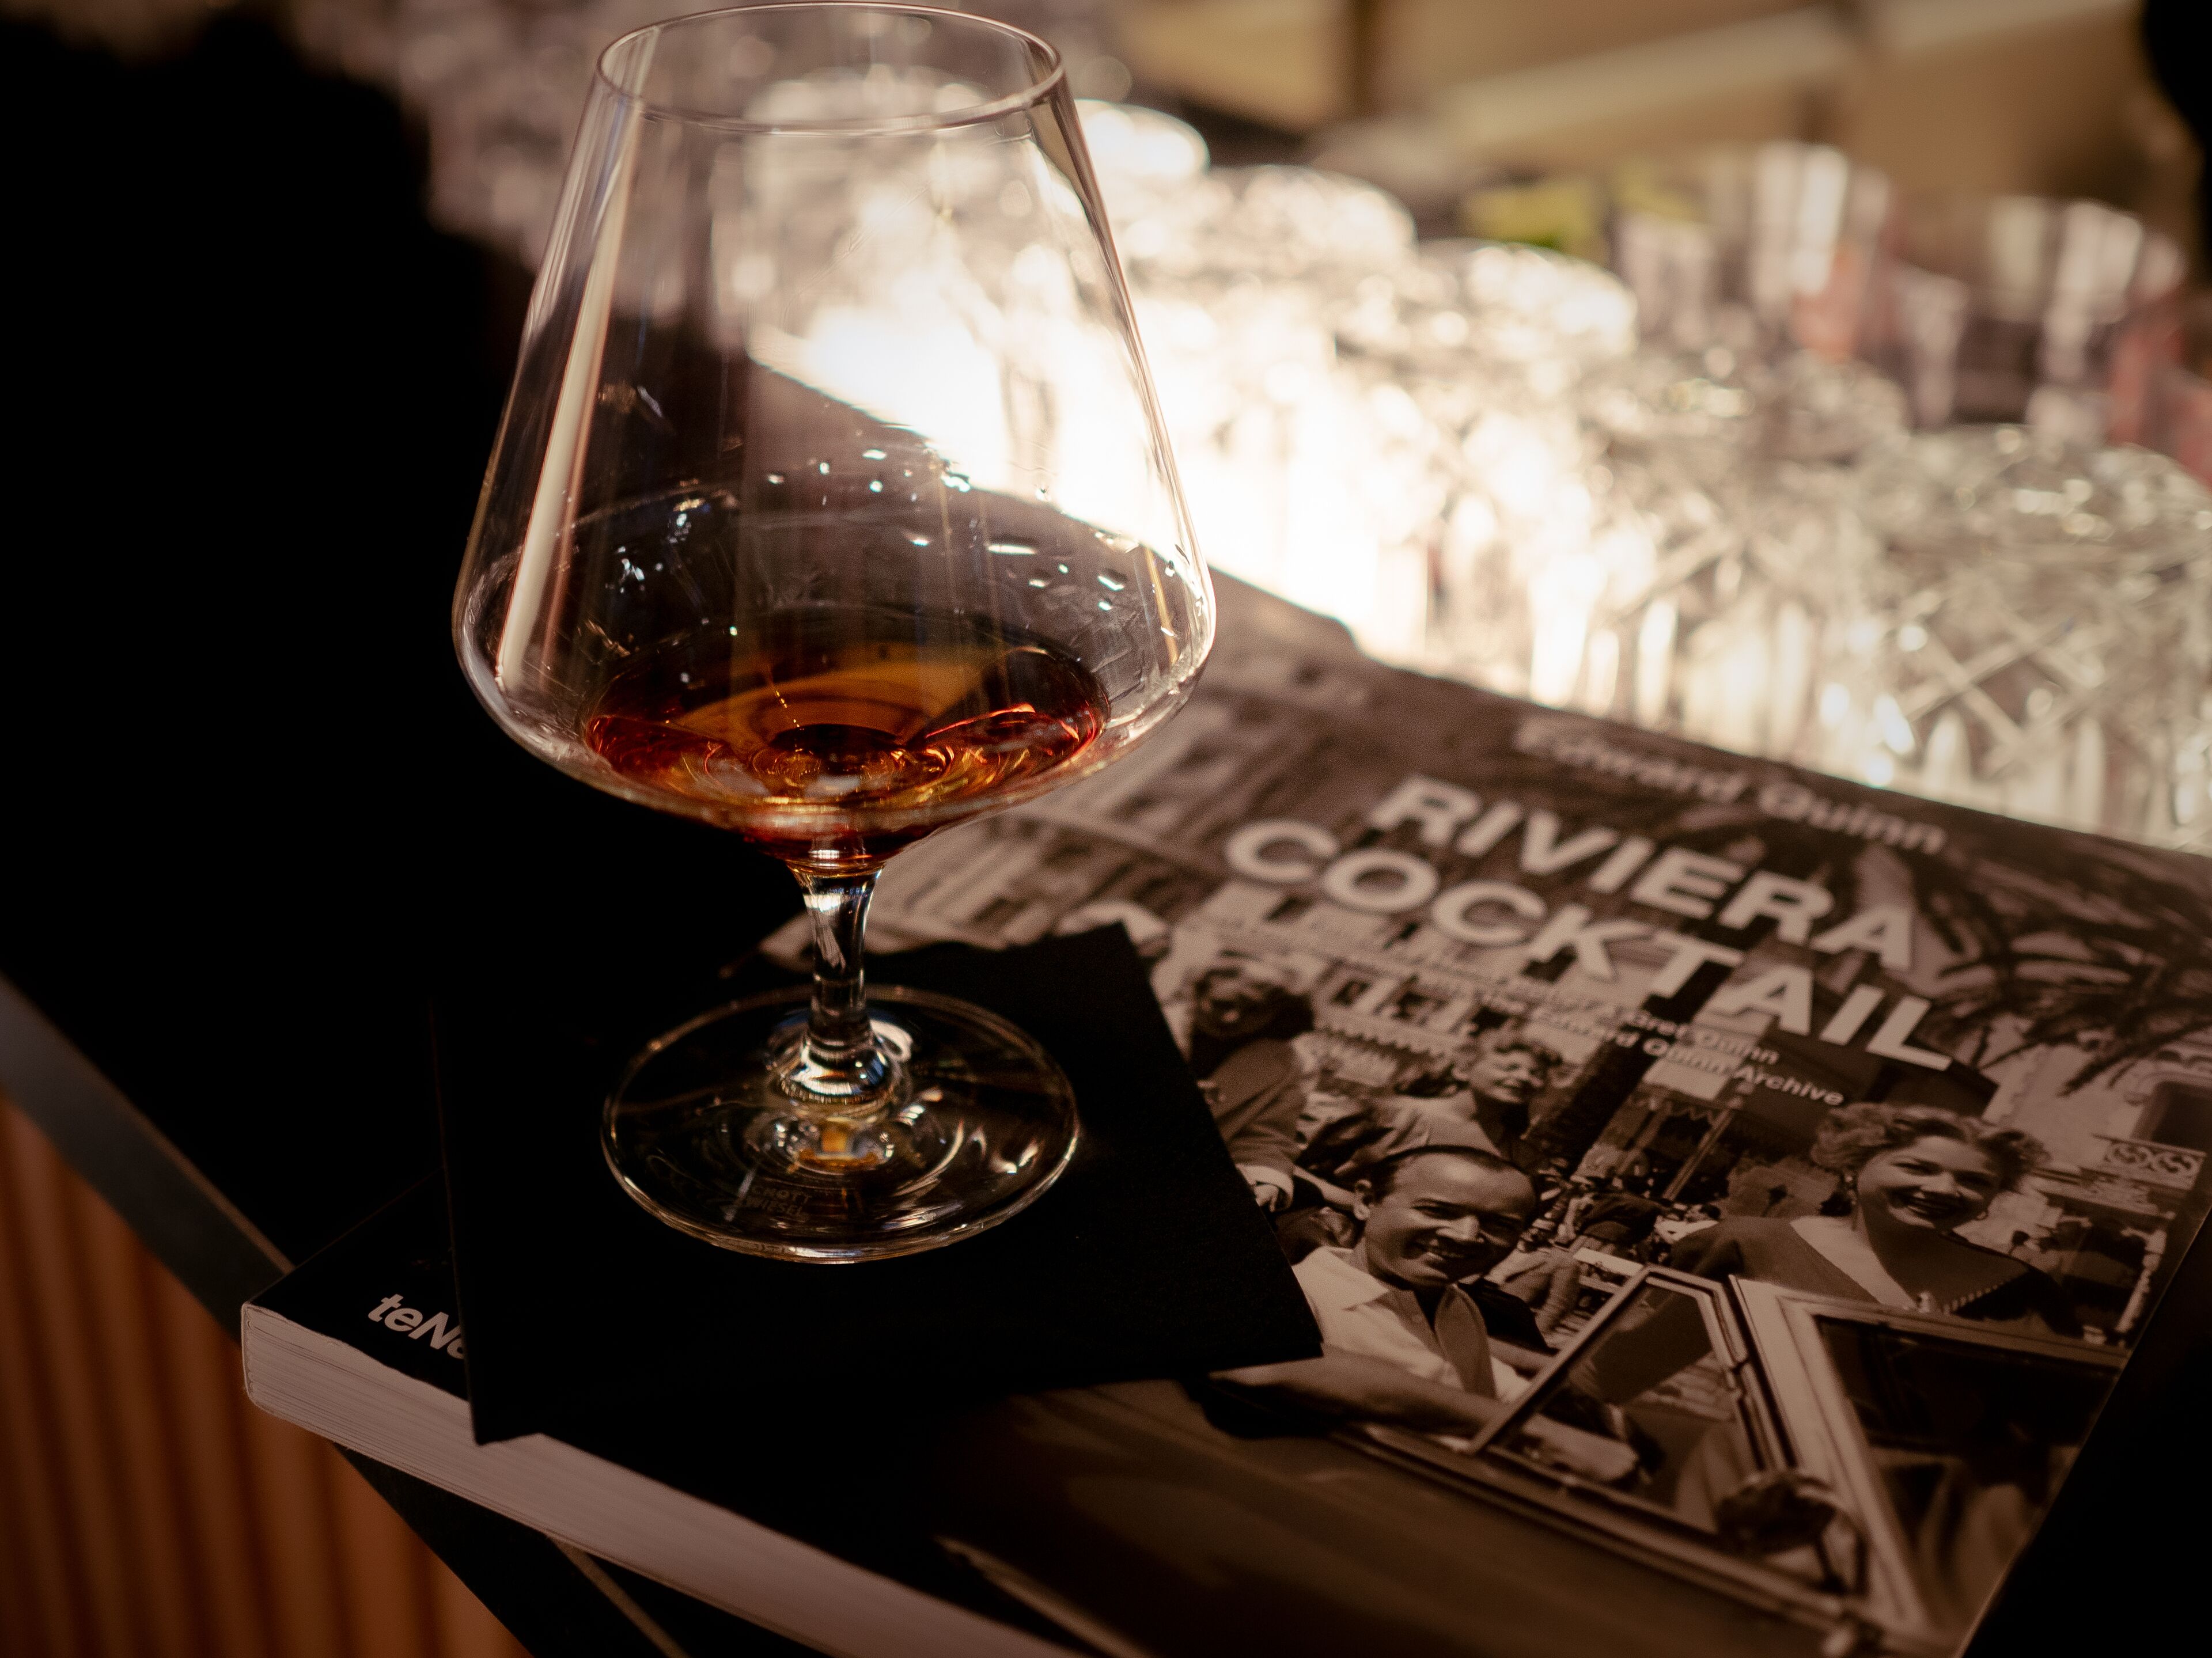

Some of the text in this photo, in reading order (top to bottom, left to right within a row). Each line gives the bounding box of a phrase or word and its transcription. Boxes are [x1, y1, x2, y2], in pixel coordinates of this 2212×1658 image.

[1758, 780, 1946, 856] Quinn
[1371, 776, 1915, 970] RIVIERA
[1224, 819, 1952, 1071] COCKTAIL
[1642, 1038, 1734, 1076] Quinn
[1734, 1065, 1843, 1106] Archive
[1694, 1028, 1779, 1065] Quinn
